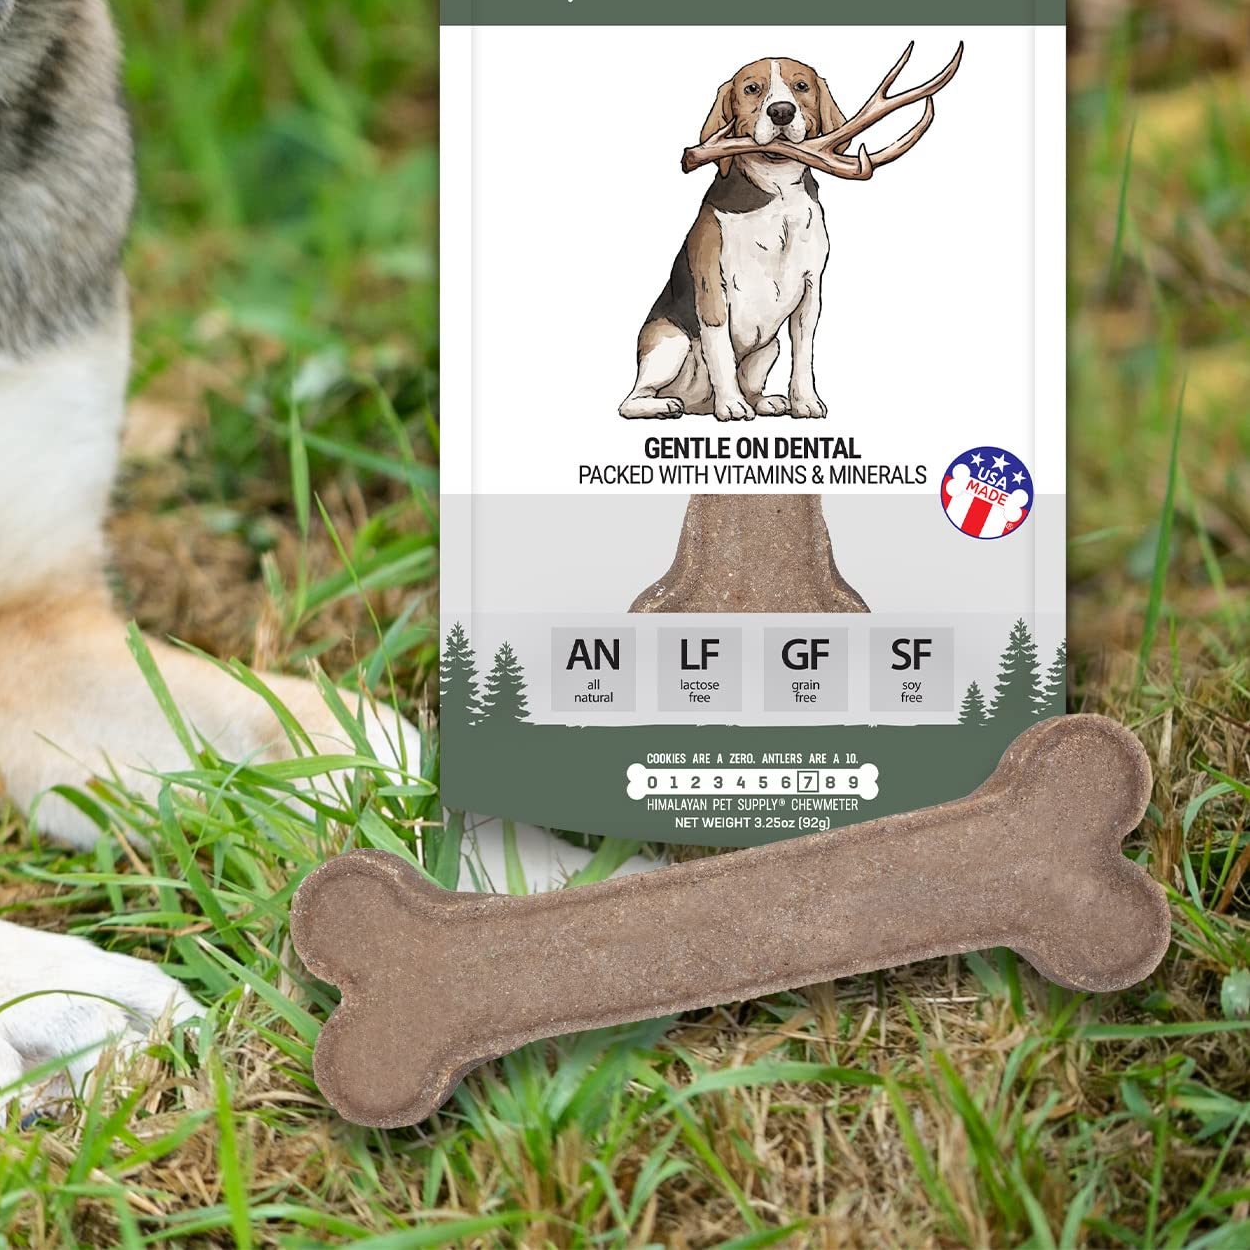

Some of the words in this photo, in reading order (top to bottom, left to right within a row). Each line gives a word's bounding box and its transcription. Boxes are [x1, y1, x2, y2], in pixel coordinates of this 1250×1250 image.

[644, 436, 732, 460] GENTLE
[735, 436, 769, 460] ON
[774, 436, 862, 460] DENTAL
[578, 464, 654, 485] PACKED
[658, 464, 709, 485] WITH
[713, 464, 807, 485] VITAMINS
[811, 464, 825, 485] &
[829, 464, 927, 485] MINERALS
[977, 467, 1007, 491] USA
[965, 479, 1009, 507] MADE
[565, 638, 620, 671] AN
[680, 638, 720, 671] LF
[781, 638, 830, 671] GF
[891, 638, 933, 671] SF
[587, 678, 600, 691] all
[680, 678, 720, 692] lactose
[791, 679, 820, 695] grain
[902, 681, 922, 695] soy
[574, 691, 614, 703] natural
[688, 691, 711, 703] free
[794, 691, 817, 703] free
[900, 691, 923, 703] free
[646, 752, 687, 765] COOKIES
[692, 752, 711, 764] ARE
[716, 752, 724, 764] A
[729, 752, 756, 765] ZERO.
[761, 752, 803, 765] ANTLERS
[808, 752, 827, 764] ARE
[832, 752, 840, 764] A
[845, 752, 859, 765] 10.
[647, 775, 658, 789] 0
[669, 775, 679, 789] 1
[690, 775, 701, 789] 2
[713, 775, 724, 789] 3
[736, 775, 746, 789] 4
[758, 775, 768, 789] 5
[781, 775, 792, 789] 6
[803, 775, 814, 789] 7
[825, 775, 836, 789] 8
[848, 775, 859, 789] 9
[647, 798, 708, 811] HIMALAYAN
[712, 798, 733, 811] PET
[791, 798, 859, 811] CHEWMETER
[675, 816, 699, 829] NET
[701, 816, 752, 829] WEIGHT
[754, 816, 796, 829] 3.25oz
